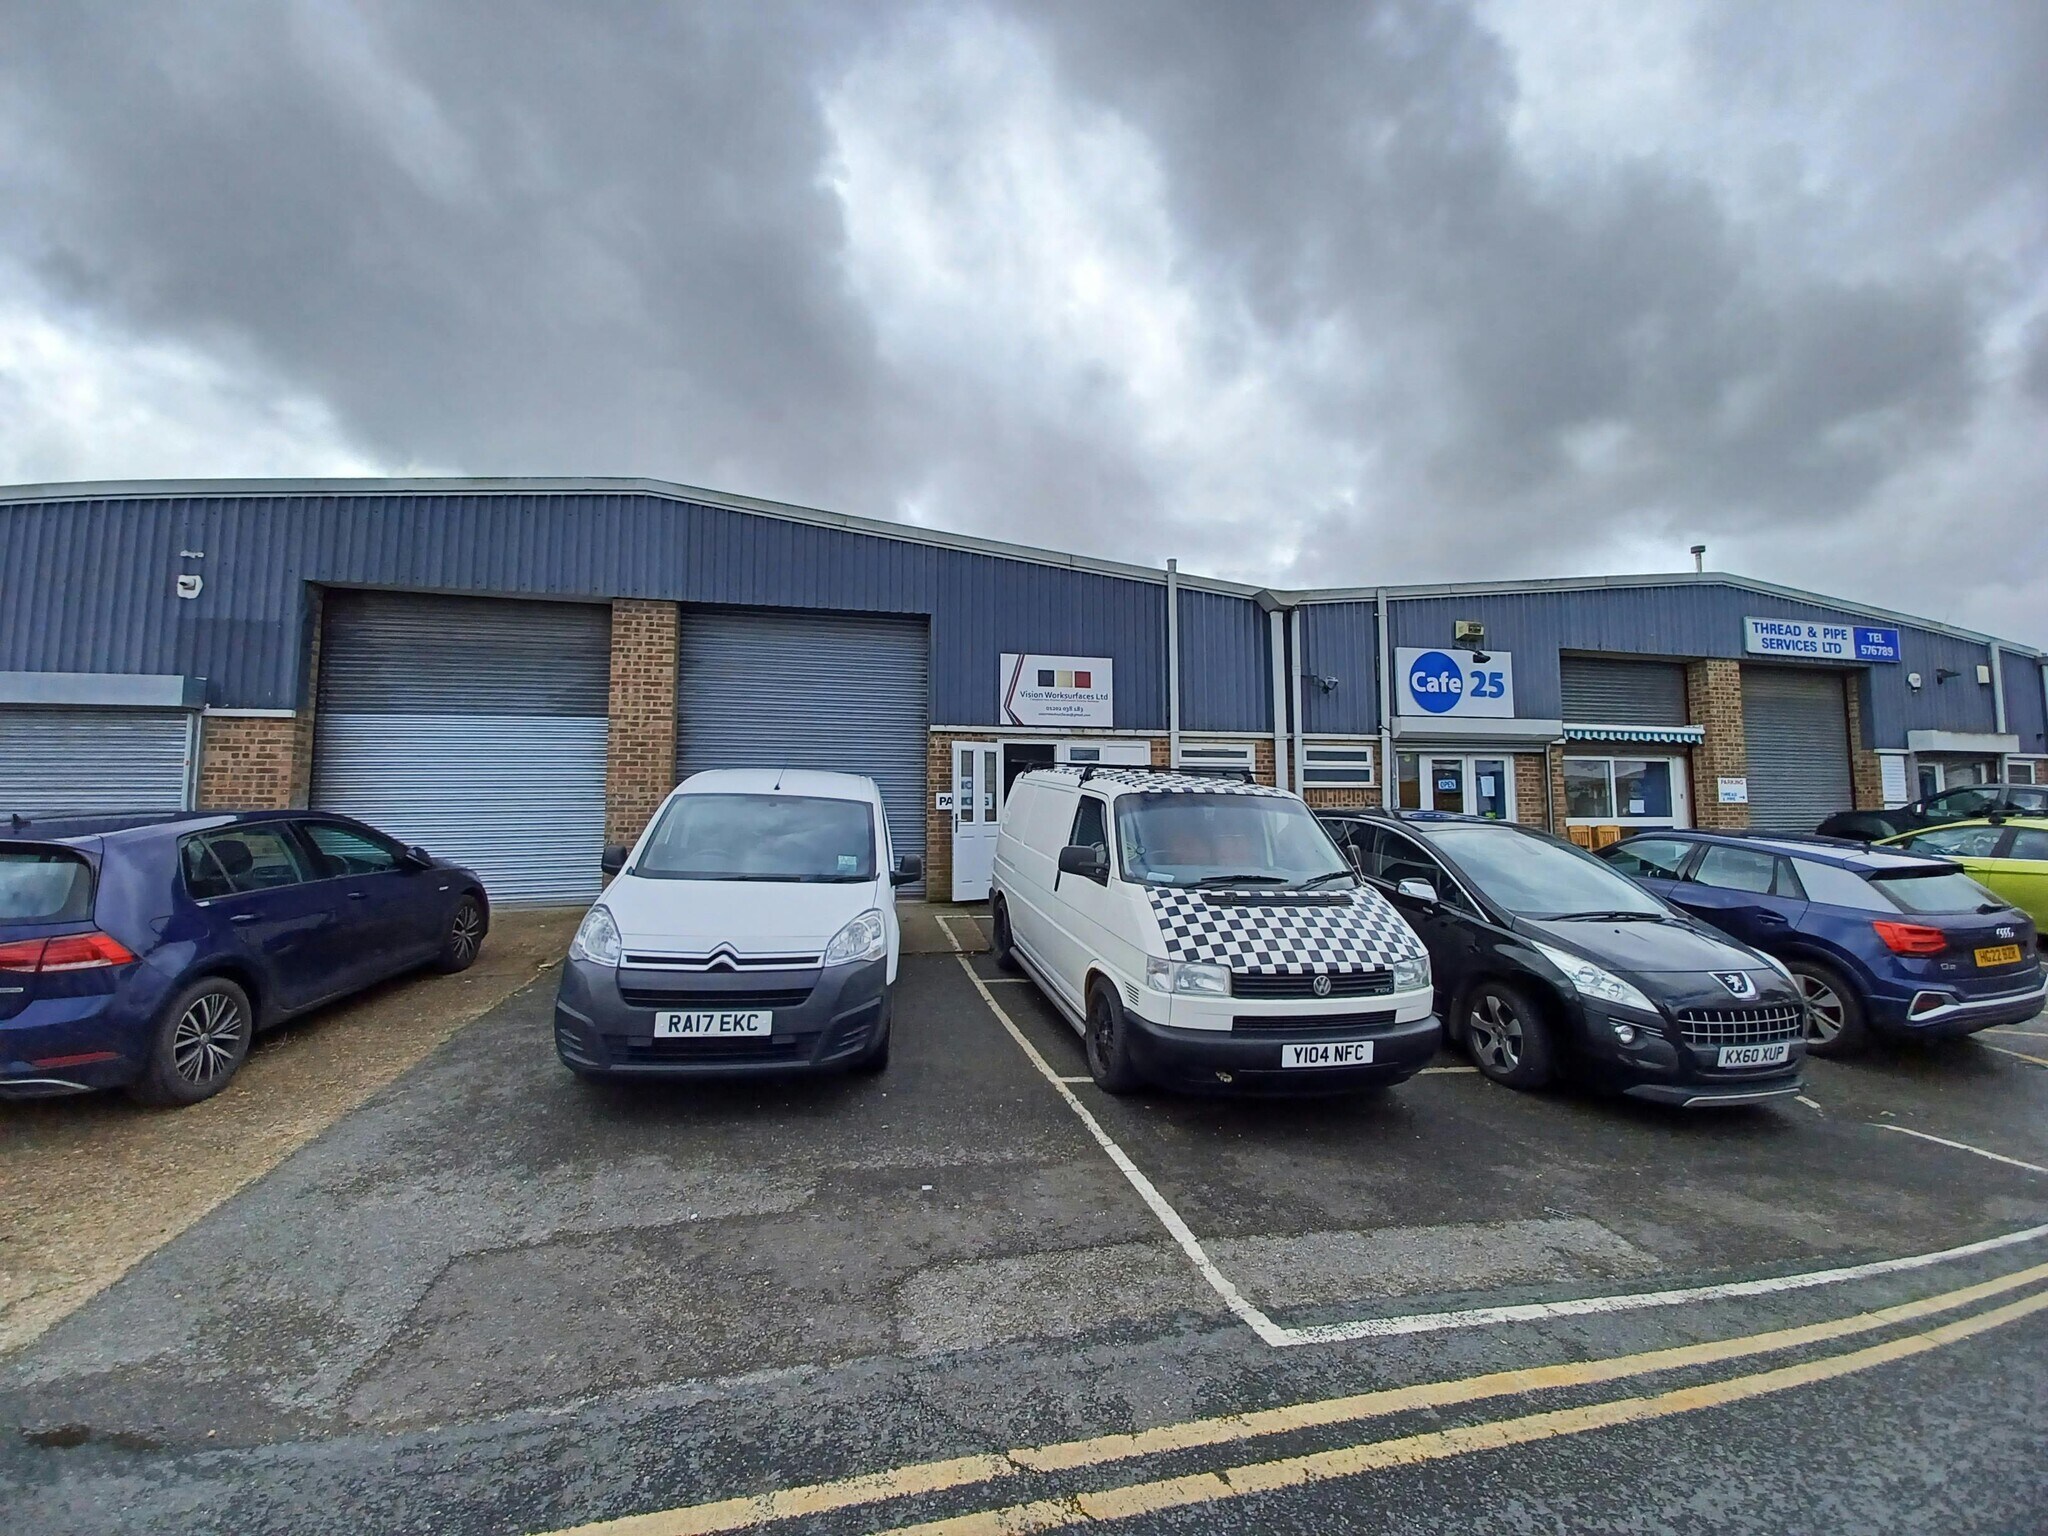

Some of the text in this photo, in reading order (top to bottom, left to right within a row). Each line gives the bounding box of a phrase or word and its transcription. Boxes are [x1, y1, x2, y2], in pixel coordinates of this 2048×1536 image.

[1752, 622, 1848, 640] THREAD & PIPE
[1867, 632, 1885, 644] TEL
[1762, 638, 1842, 654] SERVICES LTD
[1860, 646, 1893, 657] 576789
[1411, 670, 1505, 699] Cafe 25
[1020, 690, 1044, 699] Vision
[1044, 691, 1095, 701] Worksurfaces
[1095, 693, 1109, 701] Ltd
[1439, 780, 1455, 790] OPEN
[668, 1014, 759, 1033] RA17 EKC
[1294, 1044, 1364, 1064] Y104 NFC
[1724, 1046, 1784, 1064] KX60 XUP
